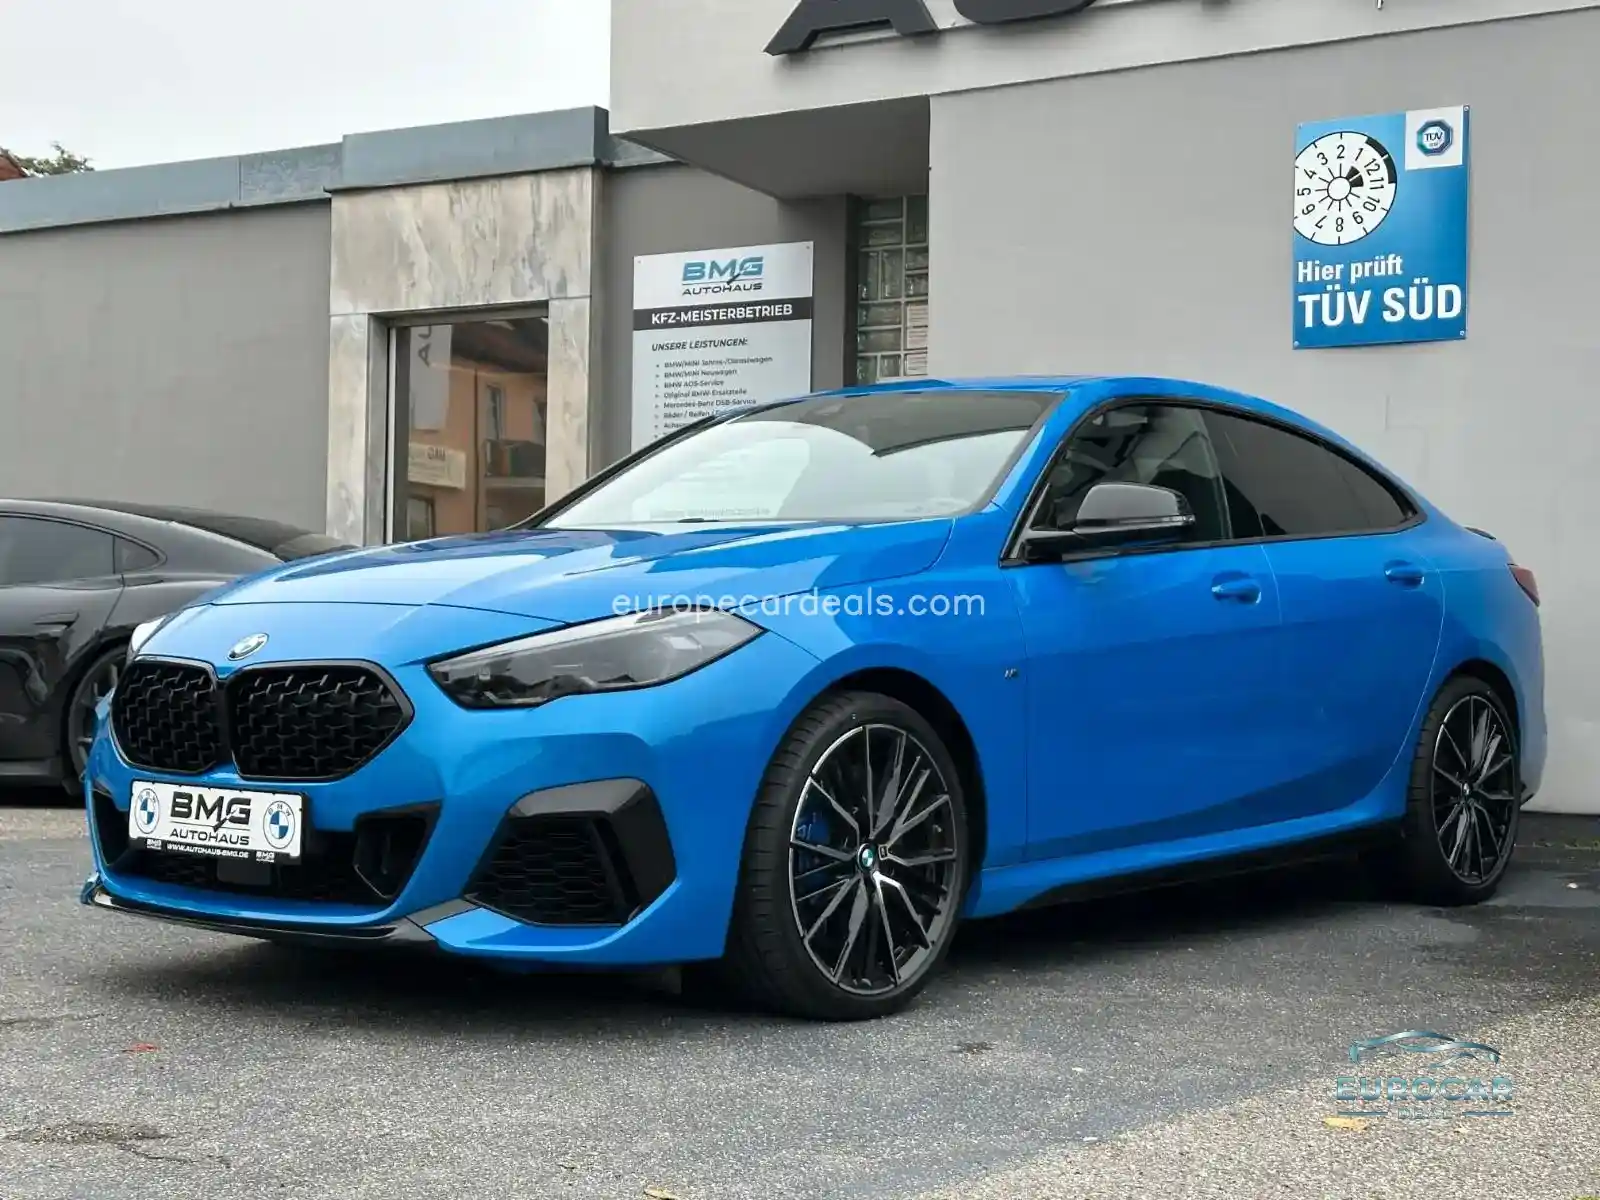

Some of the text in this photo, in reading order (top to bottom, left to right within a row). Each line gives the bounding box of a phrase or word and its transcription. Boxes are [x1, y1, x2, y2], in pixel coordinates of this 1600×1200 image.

[1317, 152, 1329, 165] 3
[1337, 145, 1345, 159] 2
[1355, 148, 1364, 161] 1
[1304, 168, 1317, 180] 4
[1364, 158, 1381, 177] 12
[1297, 187, 1312, 196] 5
[1363, 196, 1381, 212] 10
[1335, 217, 1344, 232] 8
[682, 256, 764, 282] BMG
[1297, 253, 1404, 284] Hier prüft
[682, 282, 763, 296] AUTOHAUS
[1297, 277, 1462, 328] TÜV SÜD
[651, 303, 793, 325] KFZ-MEISTERBETRIEB
[651, 337, 748, 352] UNSERE LEISTUNGEN:
[170, 791, 252, 826] BMG
[169, 828, 250, 846] AUTOHAUS
